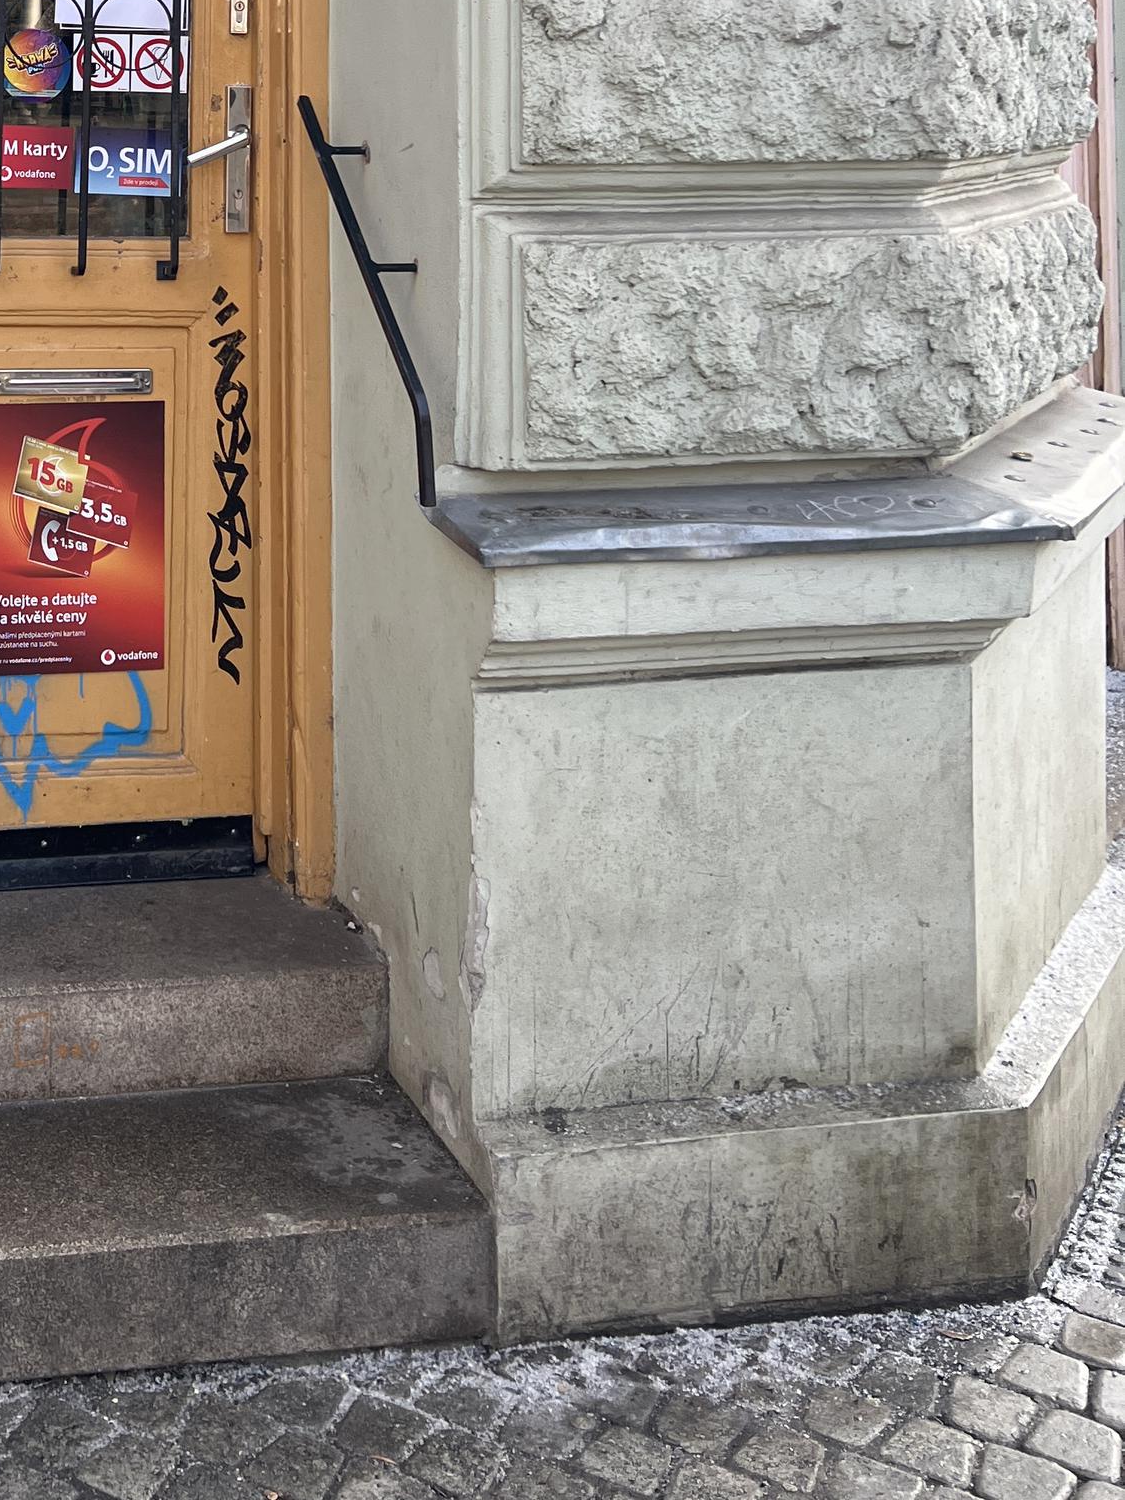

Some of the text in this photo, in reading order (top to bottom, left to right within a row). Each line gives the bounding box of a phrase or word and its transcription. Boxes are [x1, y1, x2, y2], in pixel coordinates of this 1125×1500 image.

[24, 140, 68, 160] karty
[119, 147, 172, 175] SIM
[14, 166, 56, 179] vodafone
[28, 457, 56, 486] 15
[57, 478, 73, 493] GB
[81, 498, 127, 527] 3,5 GB
[41, 597, 49, 606] a
[52, 592, 98, 607] datujte
[11, 609, 53, 624] skvělé
[56, 611, 88, 625] ceny
[117, 649, 159, 661] vodafone
